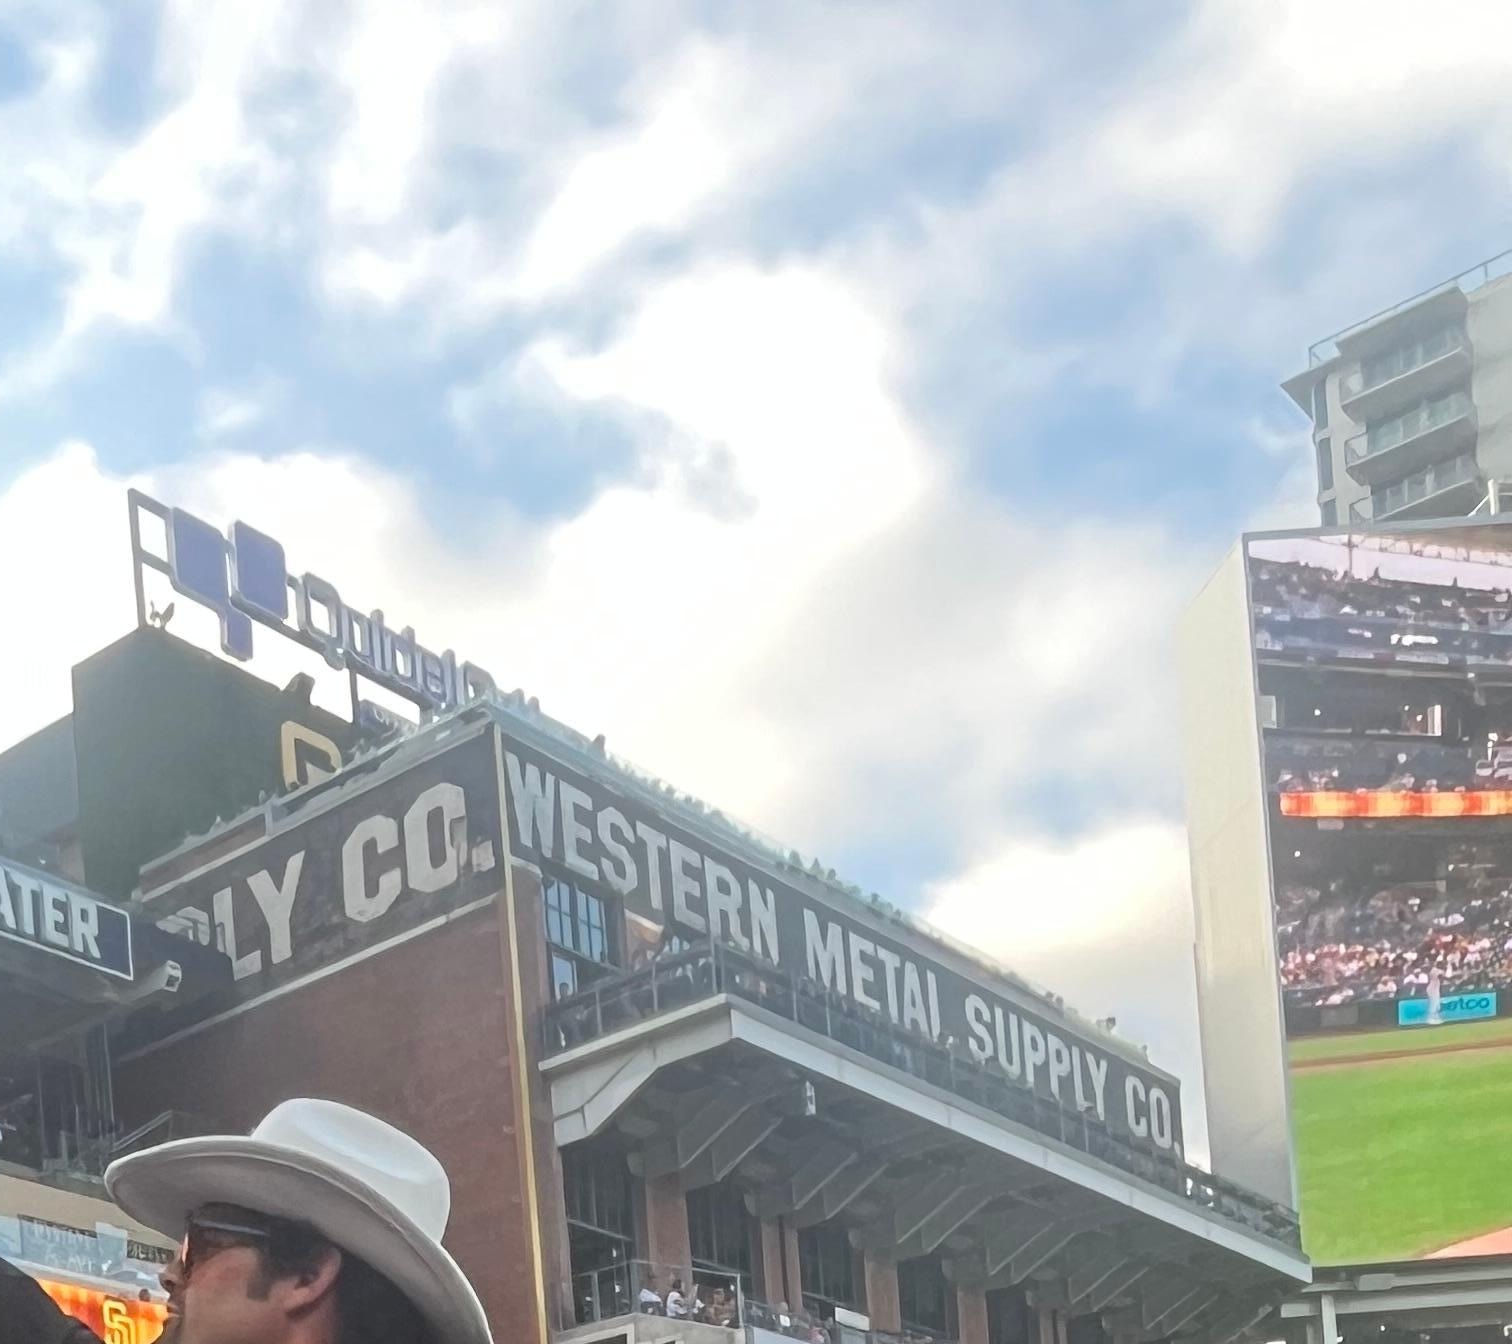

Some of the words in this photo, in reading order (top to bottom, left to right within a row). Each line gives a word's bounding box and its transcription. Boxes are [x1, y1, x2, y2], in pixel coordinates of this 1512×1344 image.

[342, 782, 495, 923] CO.
[504, 750, 781, 965] WESTERN
[803, 908, 950, 1045] METAL
[964, 993, 1108, 1123] SUPPLY
[1122, 1074, 1183, 1156] CO.
